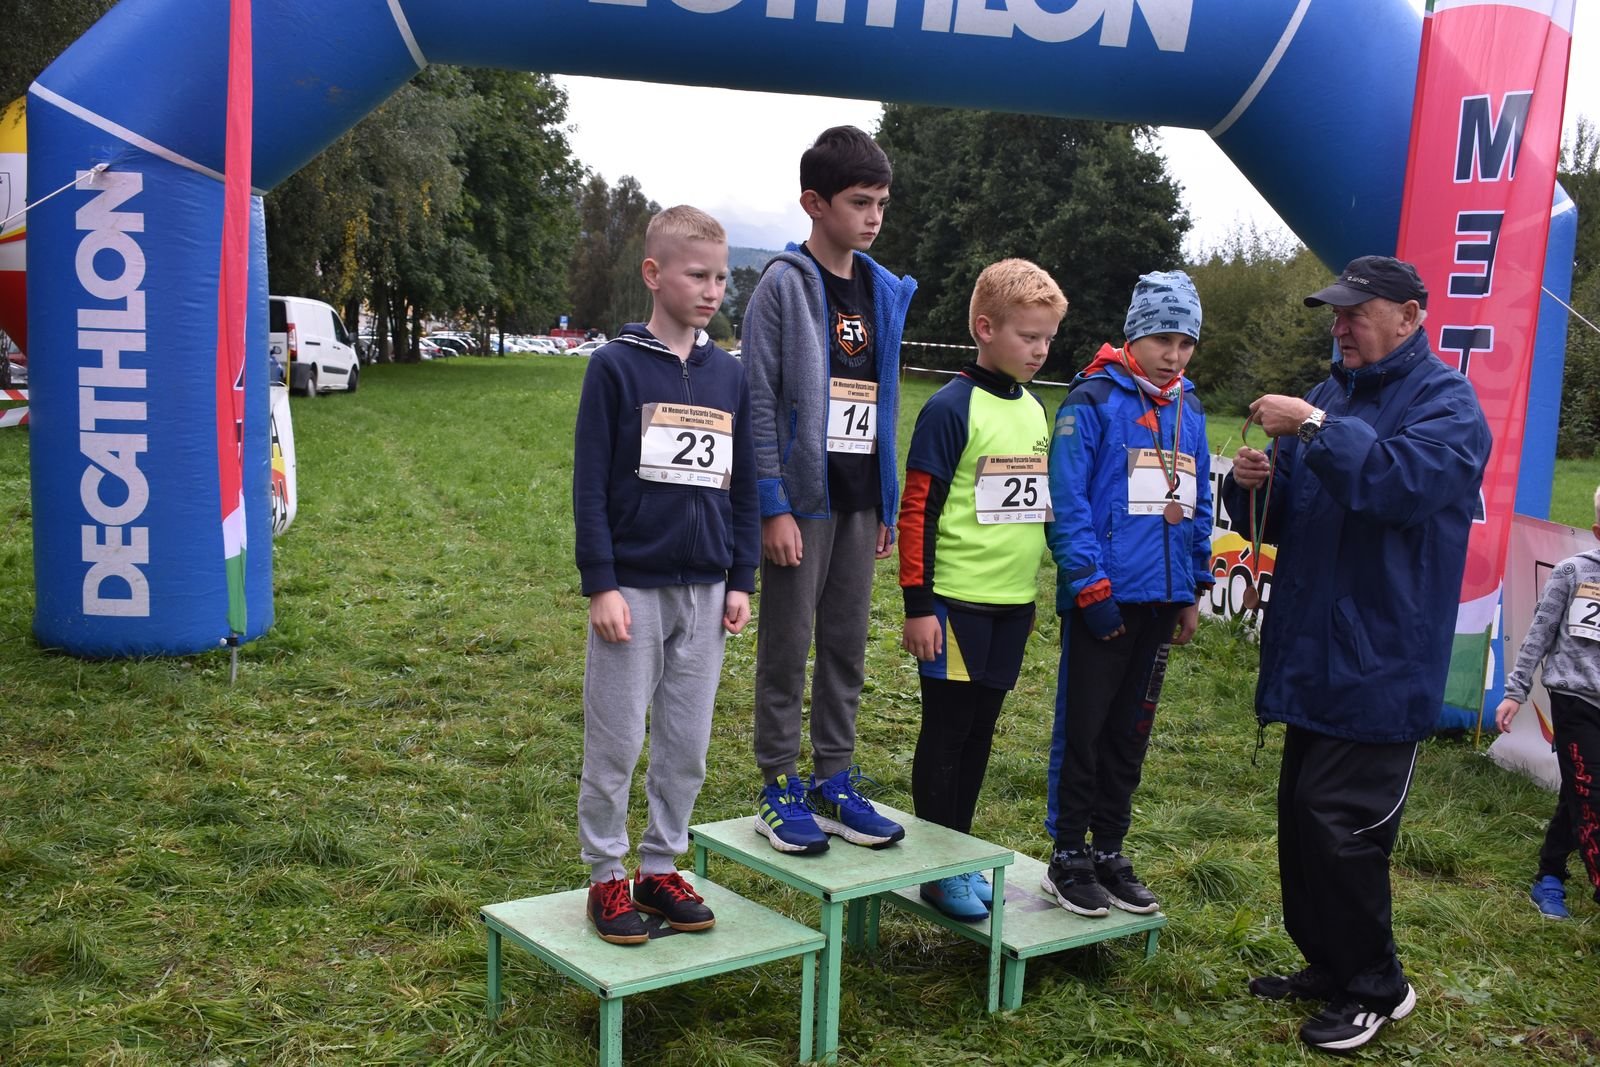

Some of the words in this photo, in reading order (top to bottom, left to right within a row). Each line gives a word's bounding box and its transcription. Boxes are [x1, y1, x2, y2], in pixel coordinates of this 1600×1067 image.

[75, 170, 150, 617] DECATHLON
[843, 404, 870, 437] 14
[671, 431, 716, 468] 23
[1001, 477, 1038, 507] 25
[1580, 601, 1600, 627] 2
